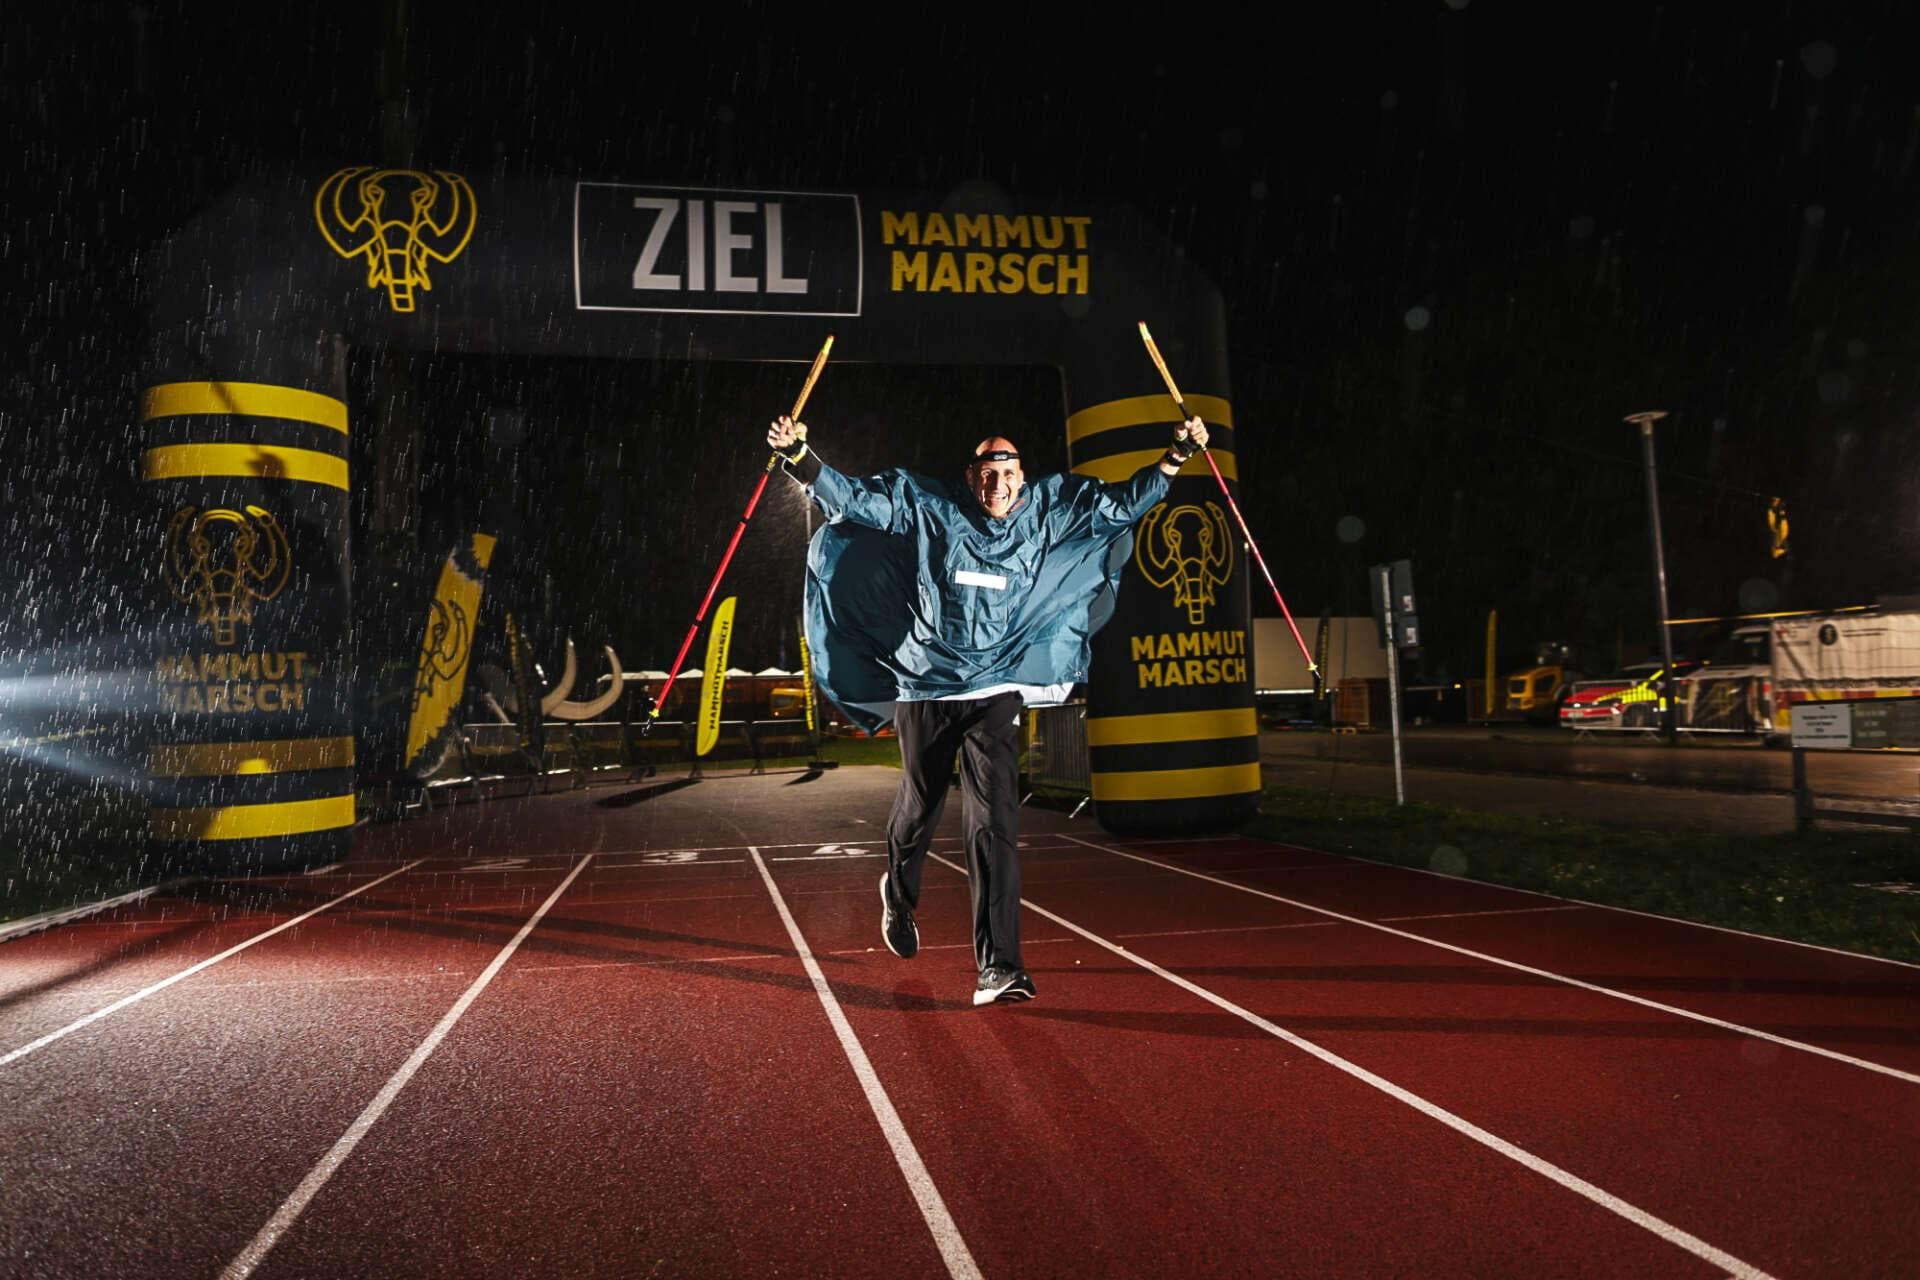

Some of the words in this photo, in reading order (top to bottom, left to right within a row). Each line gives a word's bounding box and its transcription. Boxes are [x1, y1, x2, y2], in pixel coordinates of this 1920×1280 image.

[632, 197, 808, 294] ZIEL
[880, 209, 1092, 251] MAMMUT
[891, 251, 1090, 296] MARSCH
[1130, 629, 1246, 662] MAMMUT
[156, 651, 307, 682] MAMMUT
[1137, 657, 1248, 689] MARSCH
